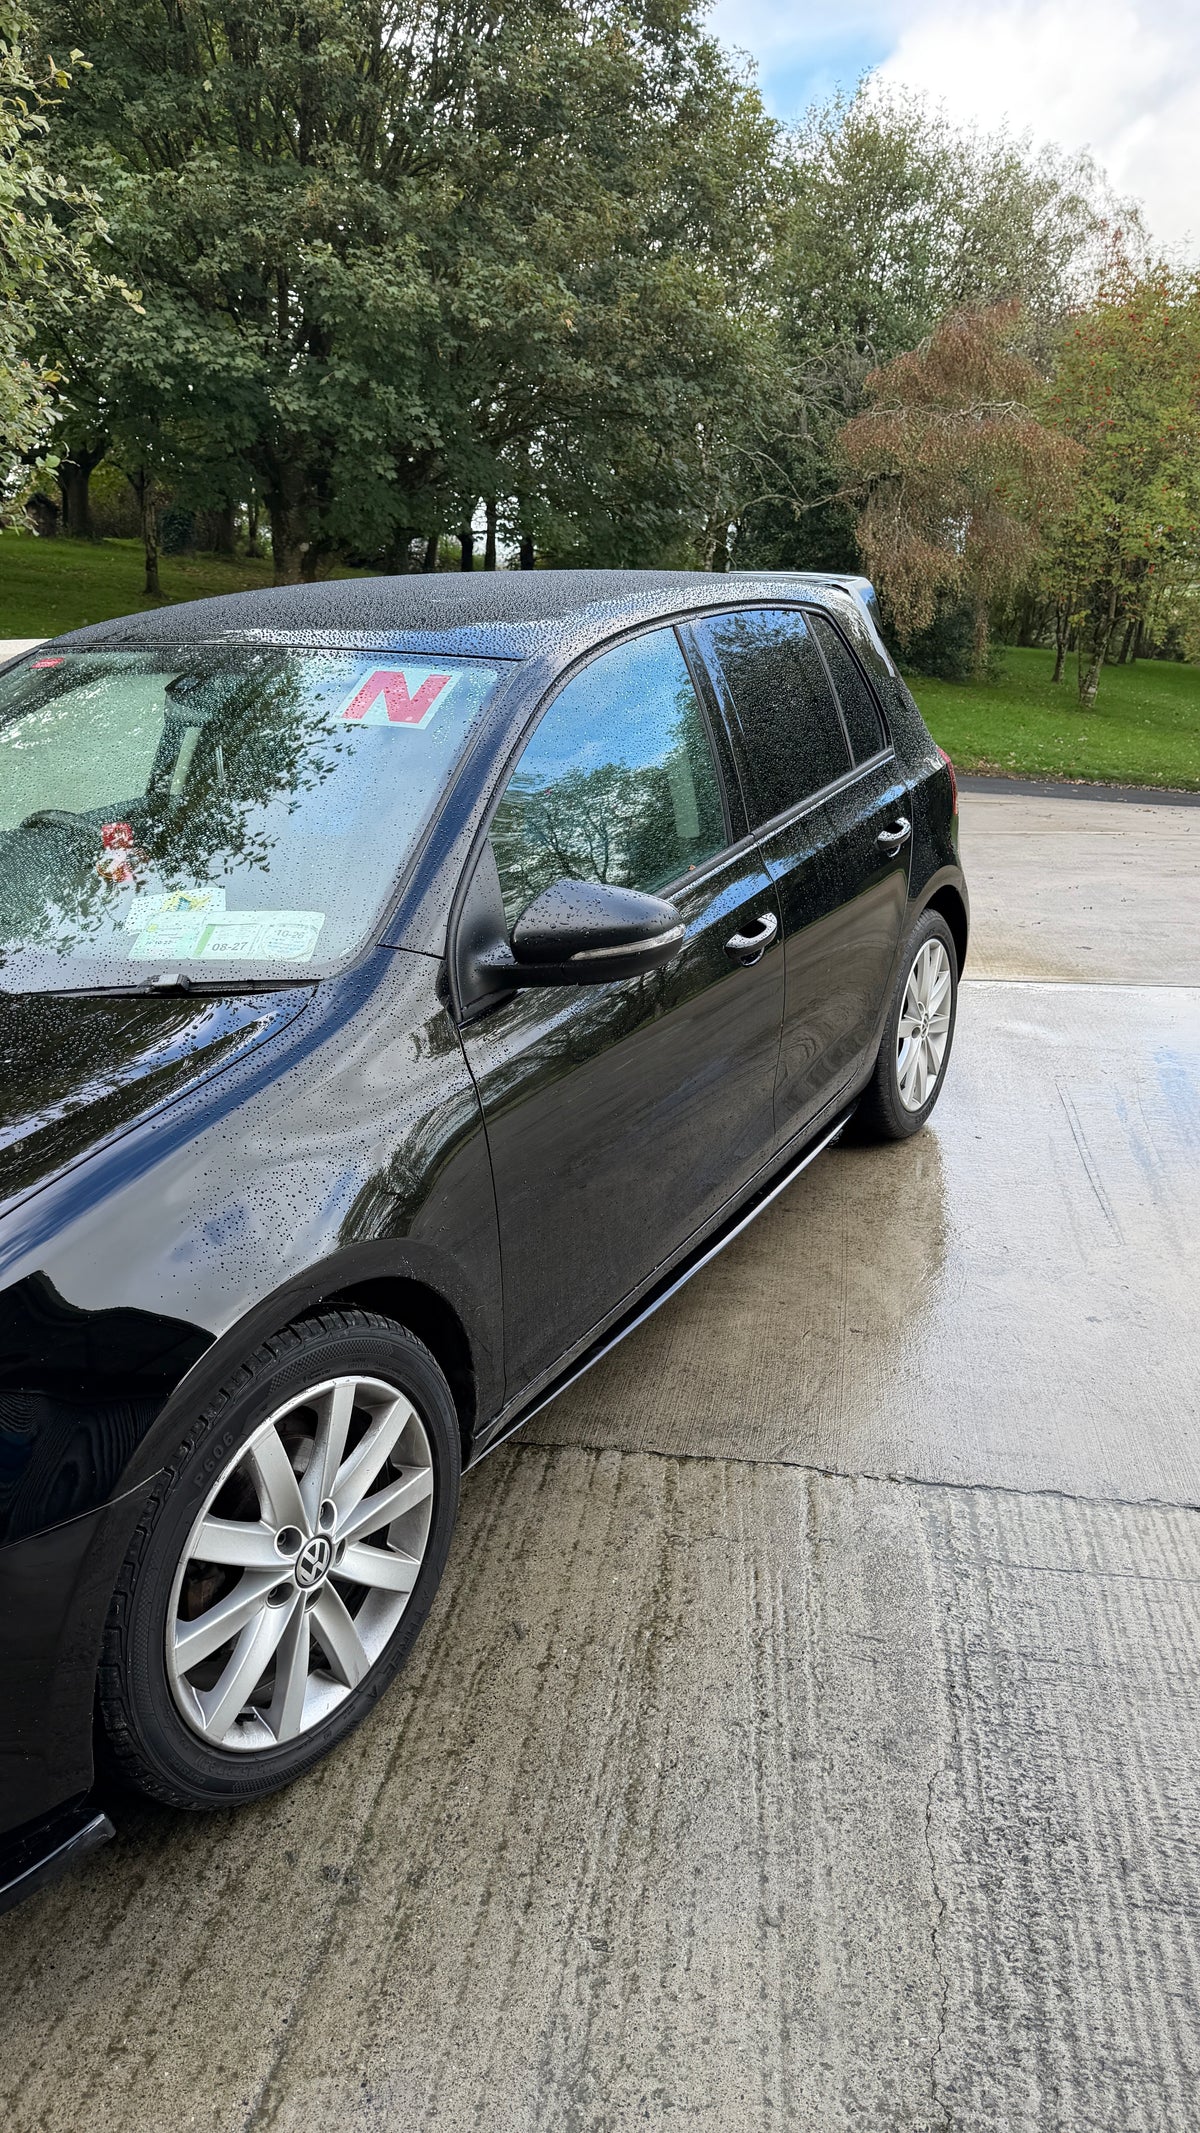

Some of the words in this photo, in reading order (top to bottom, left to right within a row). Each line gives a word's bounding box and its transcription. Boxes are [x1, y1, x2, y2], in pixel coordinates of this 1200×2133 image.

[341, 670, 452, 724] N
[212, 941, 248, 951] 08-27
[193, 1431, 234, 1489] P606
